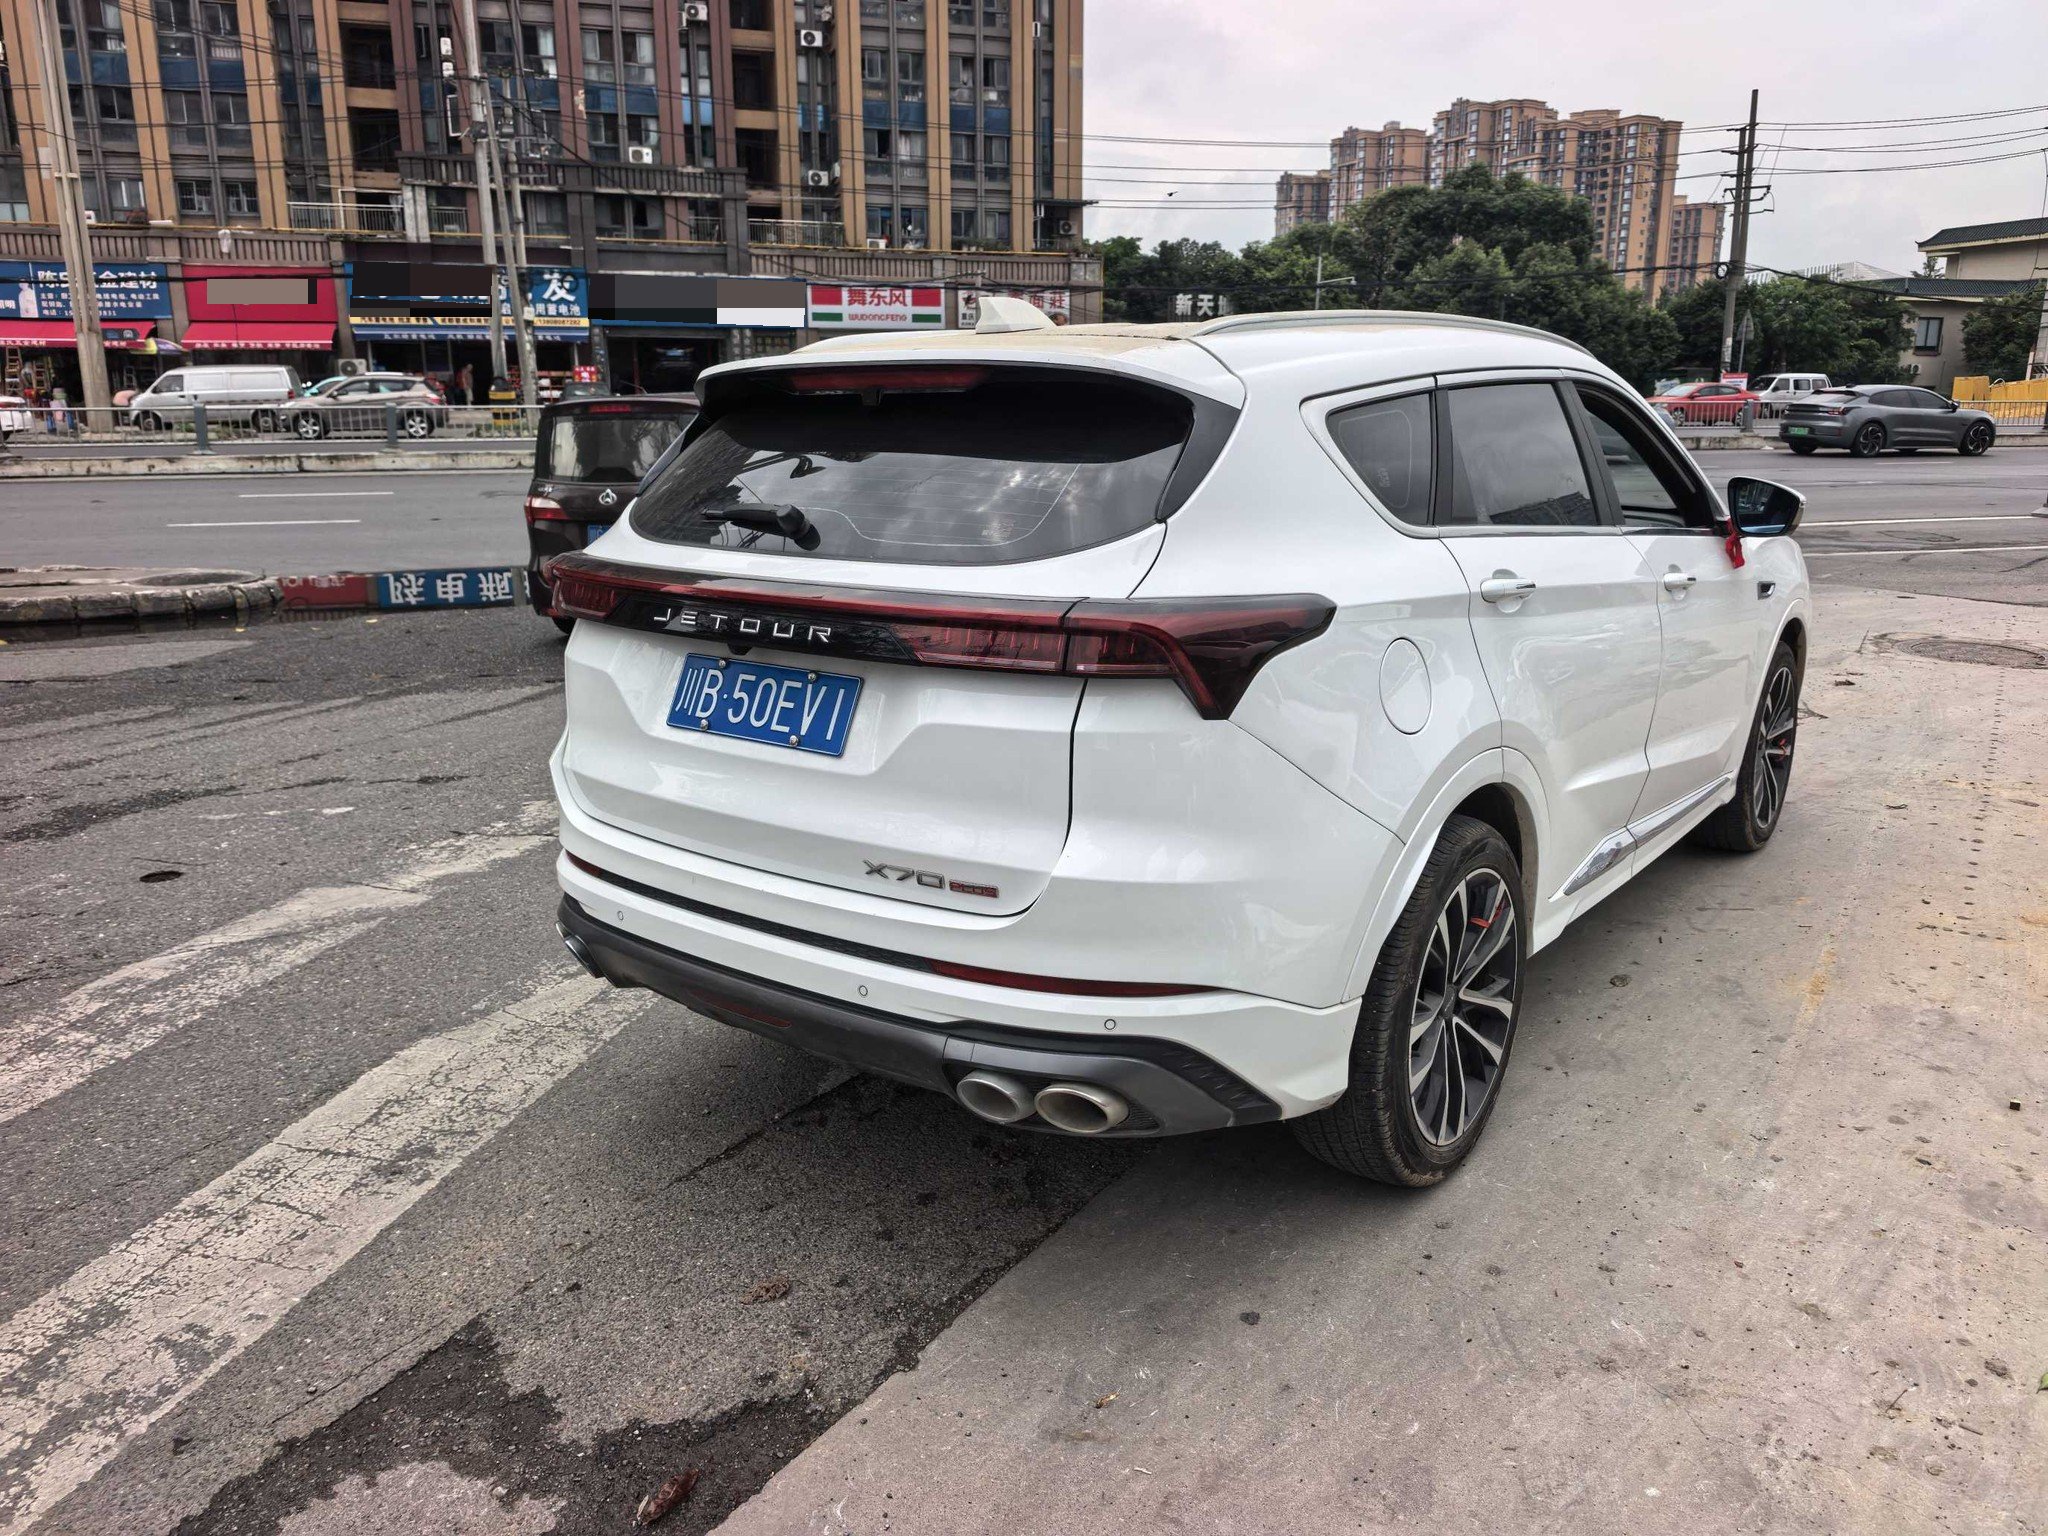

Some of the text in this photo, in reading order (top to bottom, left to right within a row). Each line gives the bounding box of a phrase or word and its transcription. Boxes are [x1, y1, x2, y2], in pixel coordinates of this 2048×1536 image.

[847, 287, 908, 307] 舞东风
[847, 313, 908, 322] WUDONGFENG
[653, 608, 832, 644] JETOUR
[862, 859, 946, 889] X70
